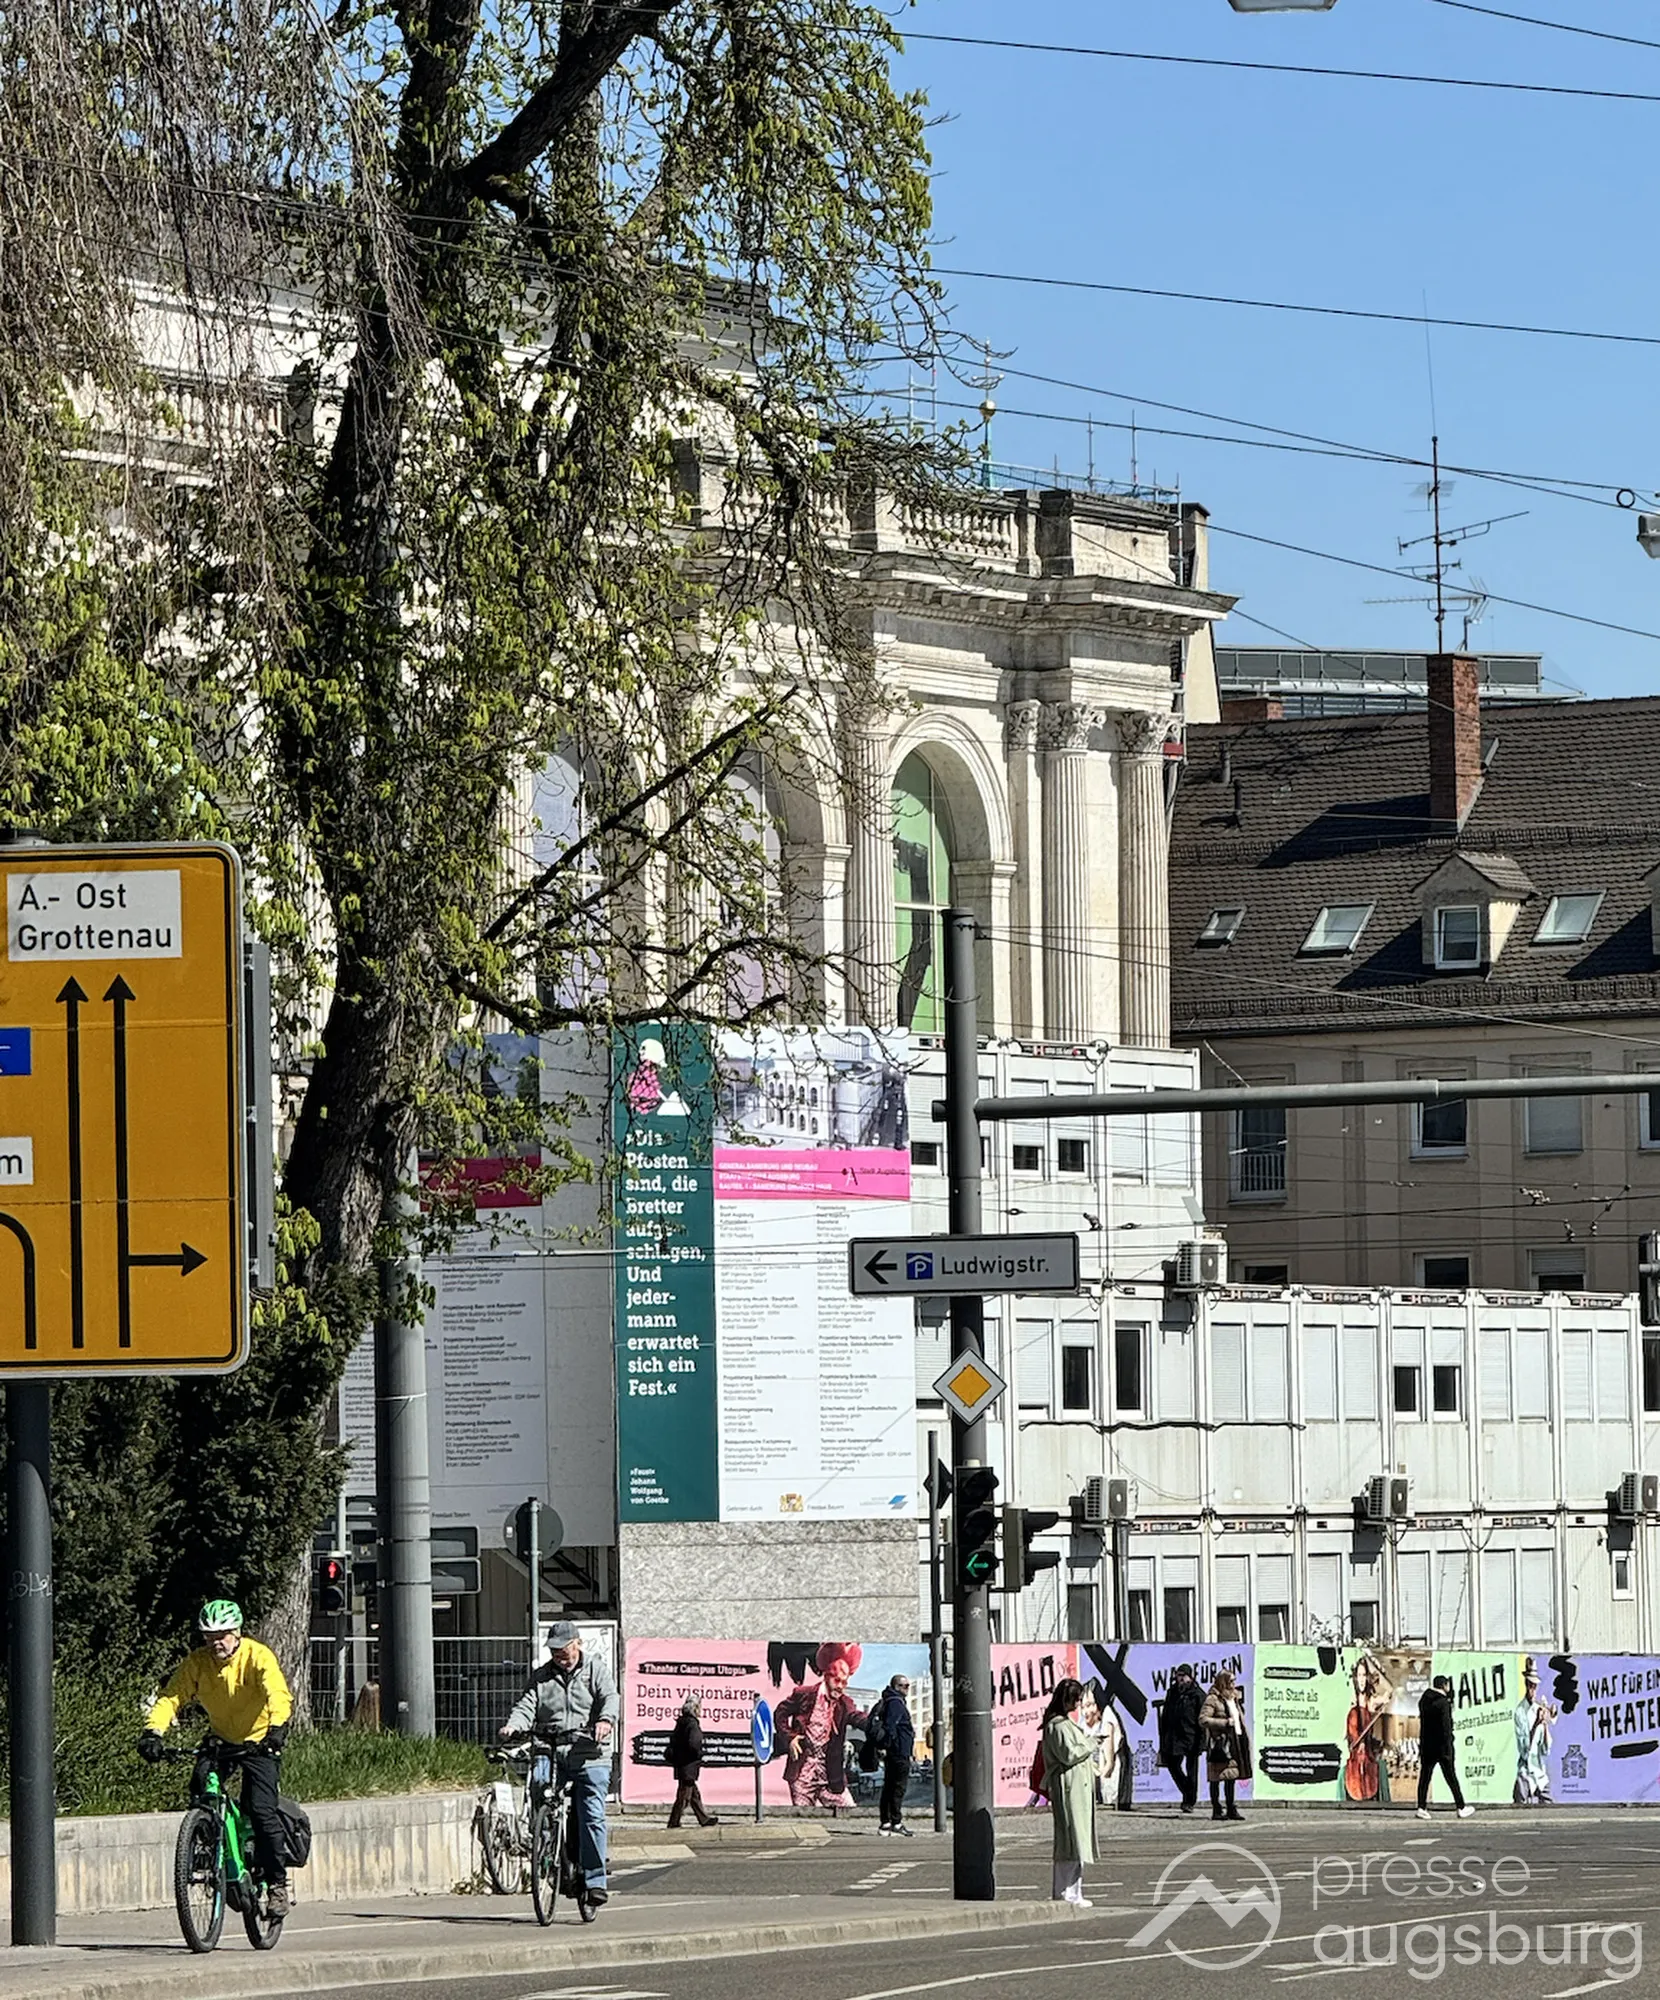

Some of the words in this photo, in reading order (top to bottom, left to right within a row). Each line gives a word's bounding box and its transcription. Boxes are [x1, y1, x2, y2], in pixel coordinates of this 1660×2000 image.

[76, 882, 127, 909] Ost
[18, 924, 172, 951] Grottenau
[626, 1152, 689, 1169] Pfosten
[625, 1174, 667, 1193] sind,
[671, 1174, 698, 1192] die
[625, 1197, 684, 1214] Bretter
[626, 1242, 706, 1264] schlgen,
[626, 1265, 662, 1283] Und
[941, 1255, 1050, 1278] Ludwigstr.
[626, 1288, 676, 1309] jeder-
[627, 1314, 677, 1328] mann
[627, 1335, 700, 1350] erwartet
[627, 1356, 664, 1373] sich
[668, 1356, 697, 1373] ein
[629, 1379, 677, 1396] Fest.«
[645, 1664, 678, 1674] Theater
[680, 1664, 716, 1676] Campus
[717, 1665, 747, 1677] Utopia
[637, 1684, 672, 1699] Dein
[676, 1684, 756, 1701] visionärer
[1263, 1687, 1284, 1701] Dein
[1286, 1688, 1305, 1702] Start
[1306, 1689, 1319, 1702] als
[1587, 1674, 1618, 1701] WAS
[1621, 1671, 1643, 1695] FÜR
[1008, 1710, 1039, 1728] Campus
[1263, 1704, 1320, 1722] professionelle
[1587, 1696, 1660, 1742] THEATE
[1263, 1723, 1308, 1738] Musikerin
